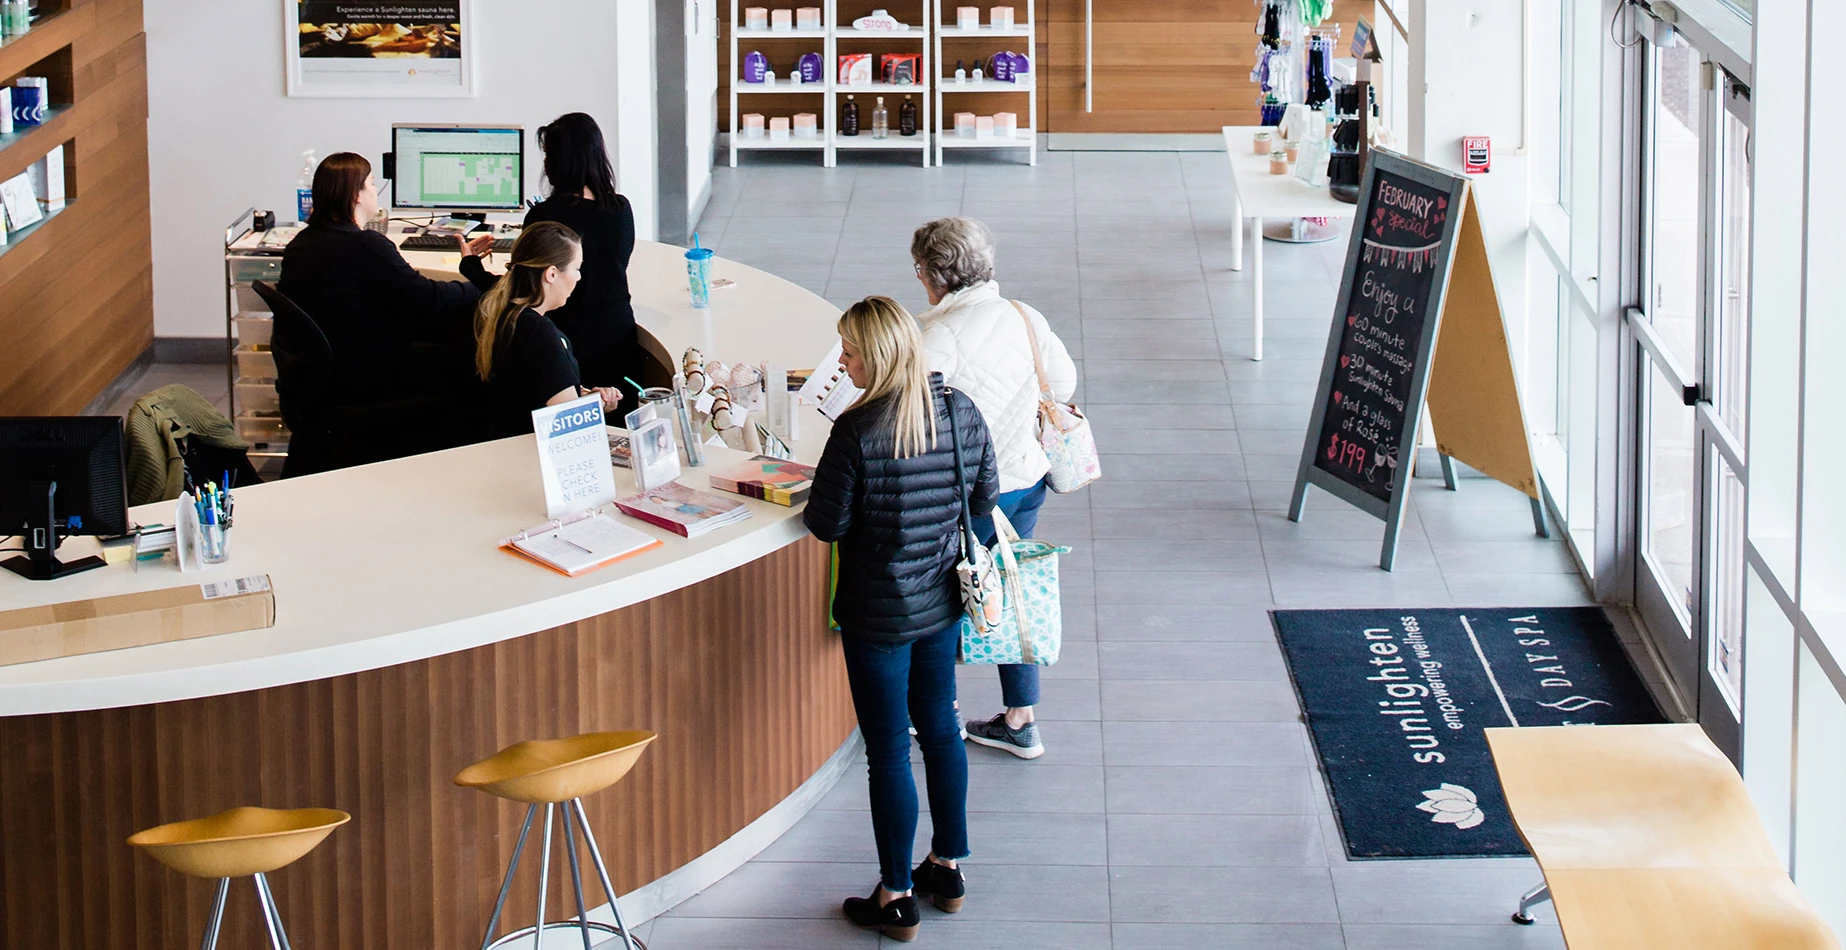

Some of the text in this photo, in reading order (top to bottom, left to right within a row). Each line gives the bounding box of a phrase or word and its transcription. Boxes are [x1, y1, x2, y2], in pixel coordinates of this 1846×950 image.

[336, 5, 373, 13] Experience
[381, 5, 416, 14] Sunlighten
[863, 19, 892, 31] strong
[1467, 140, 1488, 149] FIRE
[1378, 179, 1434, 219] FEBRUARY
[1362, 270, 1414, 324] Enjoy a
[1354, 312, 1405, 350] 60 minute
[1349, 353, 1393, 387] 30 minute
[1382, 349, 1413, 375] massage
[1348, 370, 1383, 397] Sunlighten
[1341, 395, 1392, 431] And a glass
[1342, 417, 1379, 444] of Rosé
[557, 458, 595, 478] PLEASE
[1327, 432, 1366, 474] $199
[562, 471, 598, 490] CHECK
[574, 483, 604, 500] HERE.
[1507, 614, 1573, 688] DAY SPA
[1400, 615, 1465, 731] empowering wellness
[1363, 626, 1446, 764] sunlighten
